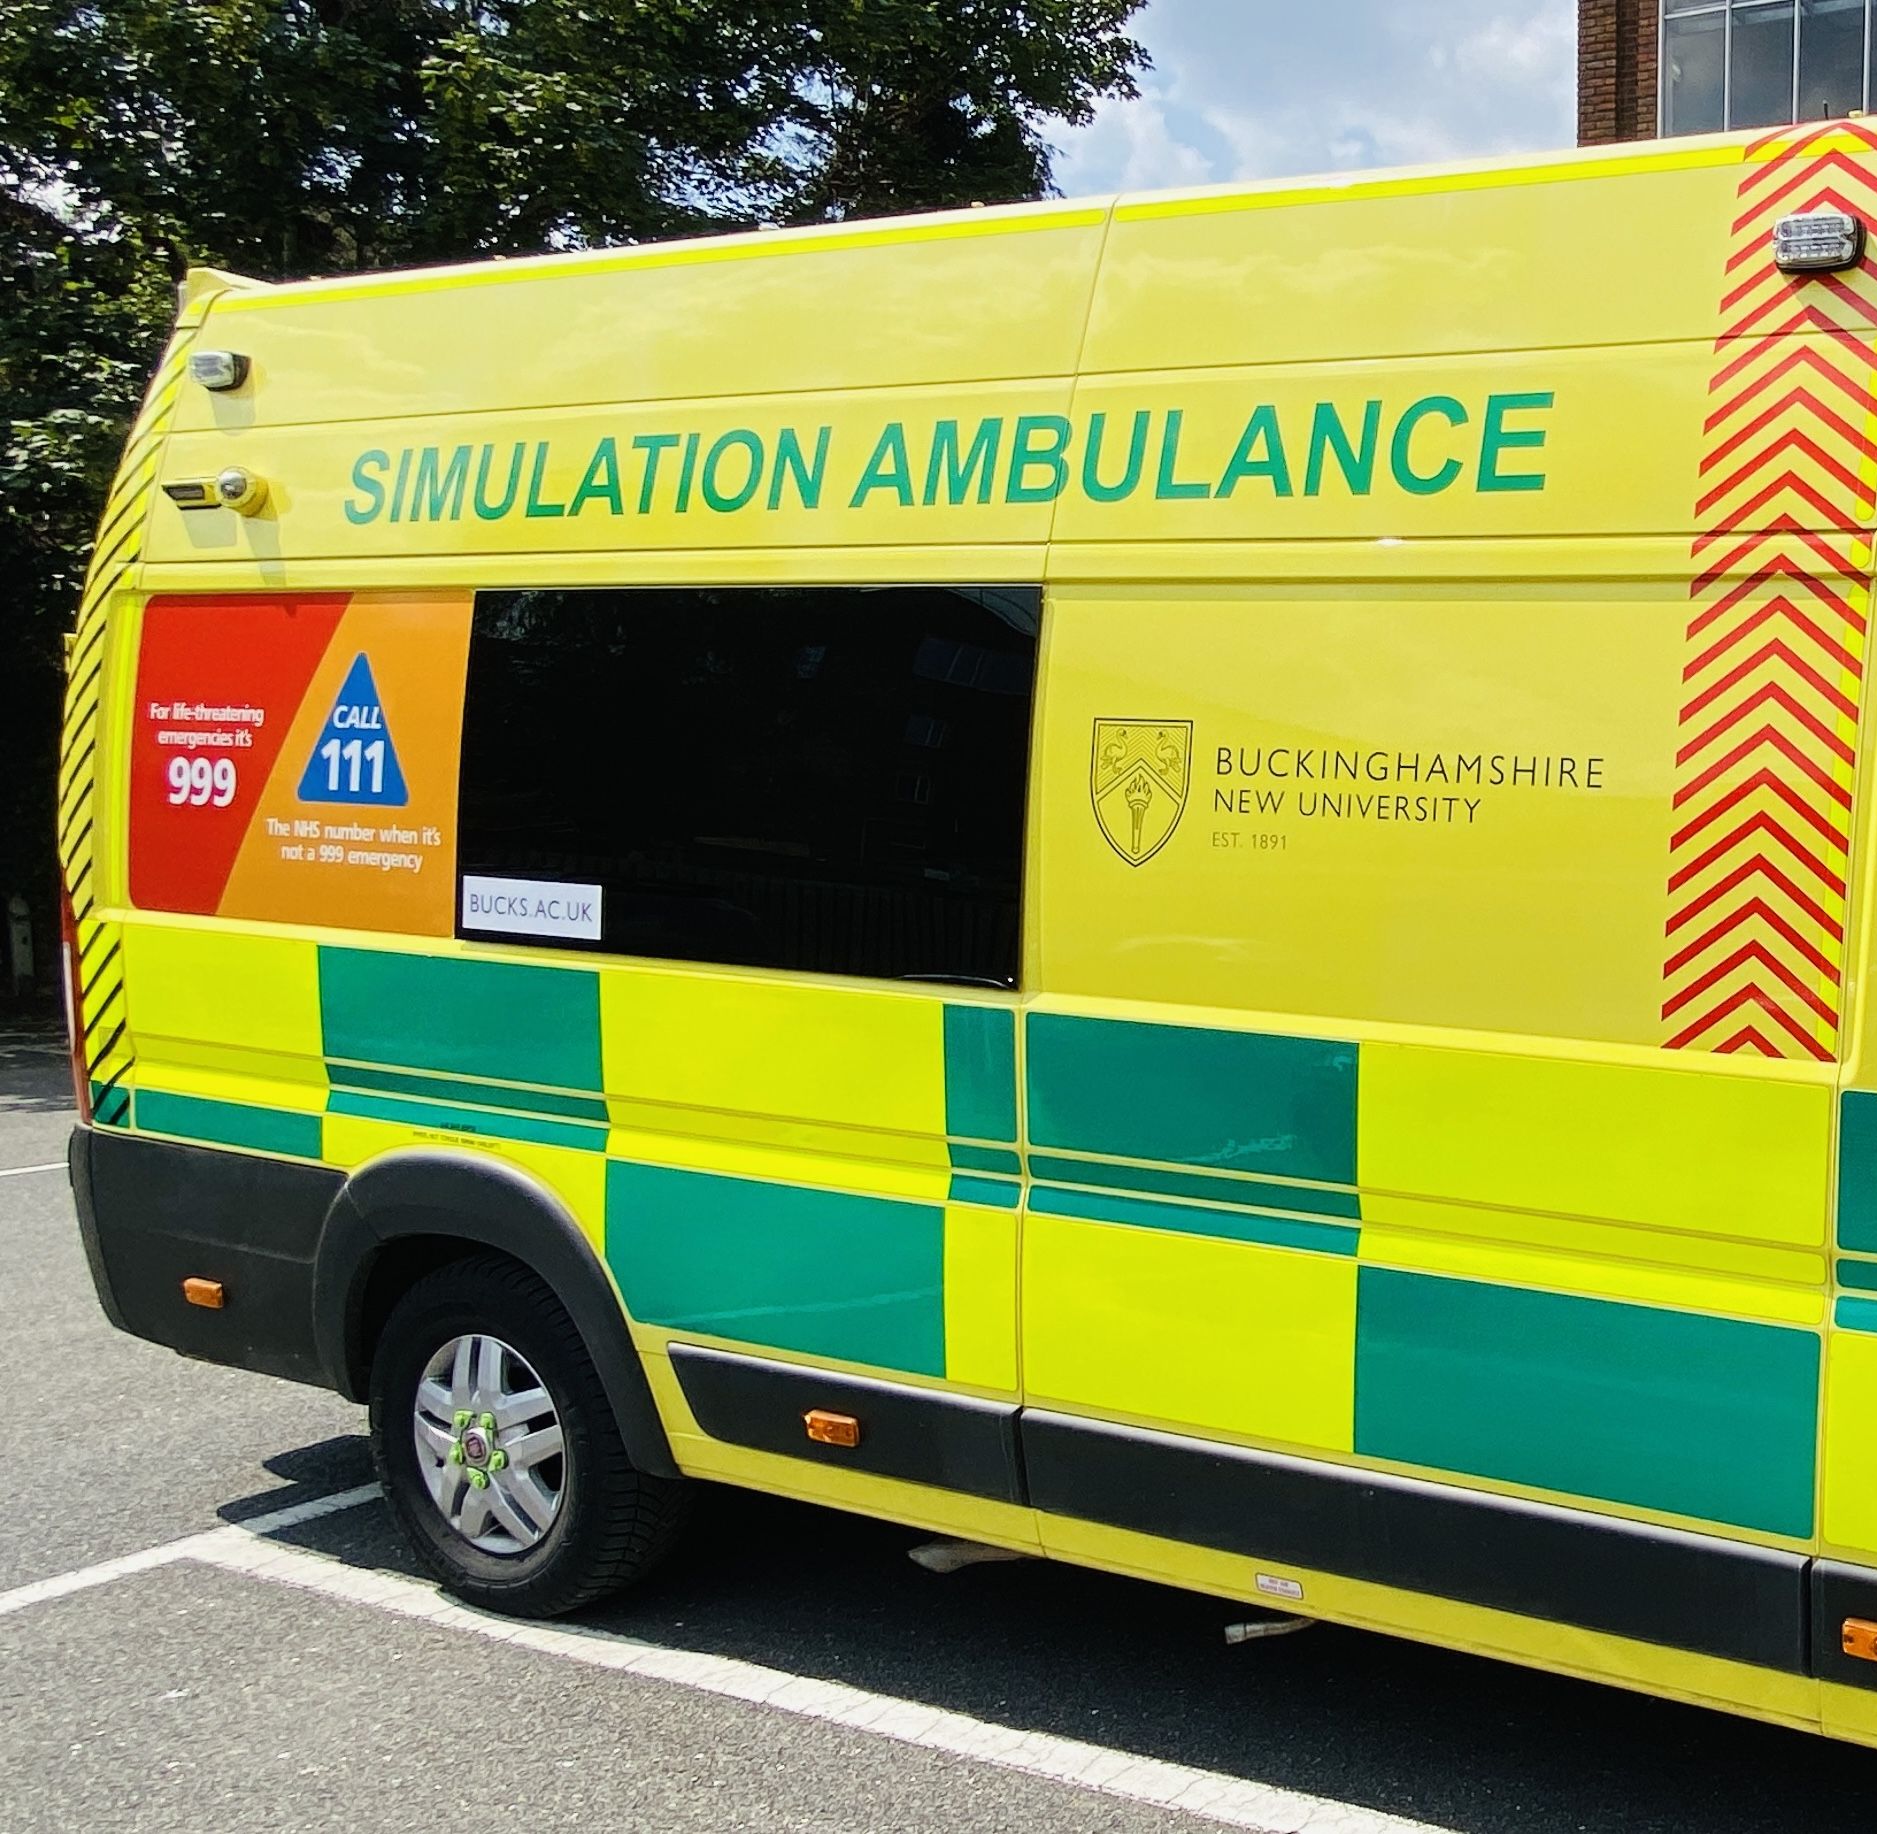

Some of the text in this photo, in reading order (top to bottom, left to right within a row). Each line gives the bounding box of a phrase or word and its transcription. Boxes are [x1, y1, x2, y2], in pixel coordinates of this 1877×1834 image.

[344, 391, 1555, 525] SIMULATION AMBULANCE
[149, 702, 265, 728] For life-threatening
[332, 704, 382, 730] CALL
[157, 728, 234, 750] emergencies
[320, 738, 385, 793] 111
[1215, 747, 1606, 790] BUCKINGHAMSHIRE
[168, 756, 237, 808] 999
[1213, 788, 1483, 824] NEW UNIVERSITY
[266, 817, 442, 847] The NHS number when it's
[1212, 831, 1287, 850] EST. 1891
[280, 843, 424, 874] not a 999 emergency
[469, 893, 593, 923] BUCKS.AC.UK
